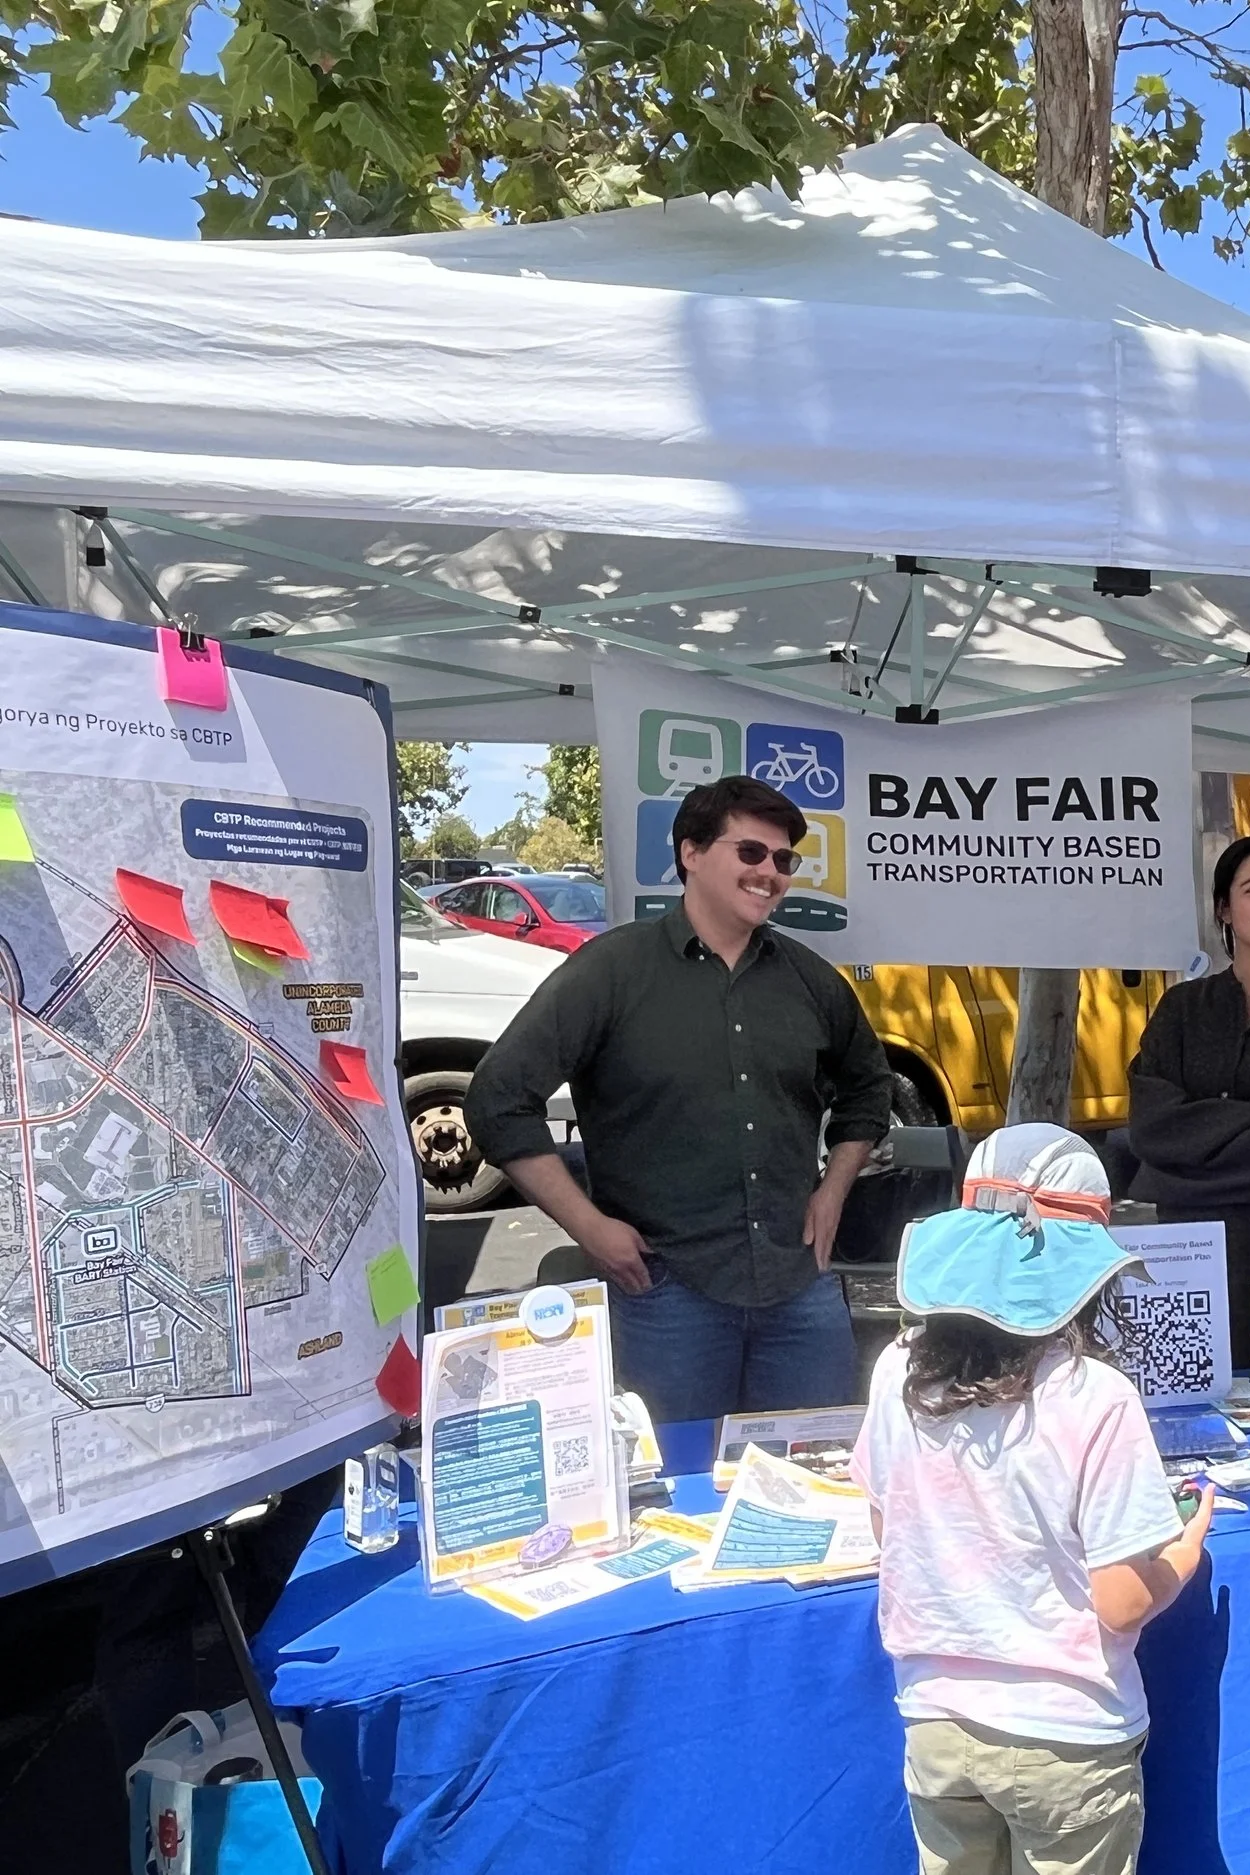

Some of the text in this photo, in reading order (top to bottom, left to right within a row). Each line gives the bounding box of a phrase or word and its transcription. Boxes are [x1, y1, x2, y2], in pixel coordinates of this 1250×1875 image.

[56, 714, 79, 732] ng
[86, 713, 165, 737] Proyekto
[170, 727, 188, 741] sa
[192, 727, 232, 746] CBTP
[868, 774, 1161, 822] BAY FAIR
[867, 831, 1161, 859] COMMUNITY BASED
[867, 863, 1163, 886] TRANSPORTATION PLAN
[857, 966, 871, 979] 15
[307, 1000, 352, 1016] ALAMEDA
[1141, 1241, 1187, 1251] Community
[1189, 1240, 1213, 1248] Based
[74, 1271, 101, 1284] BART
